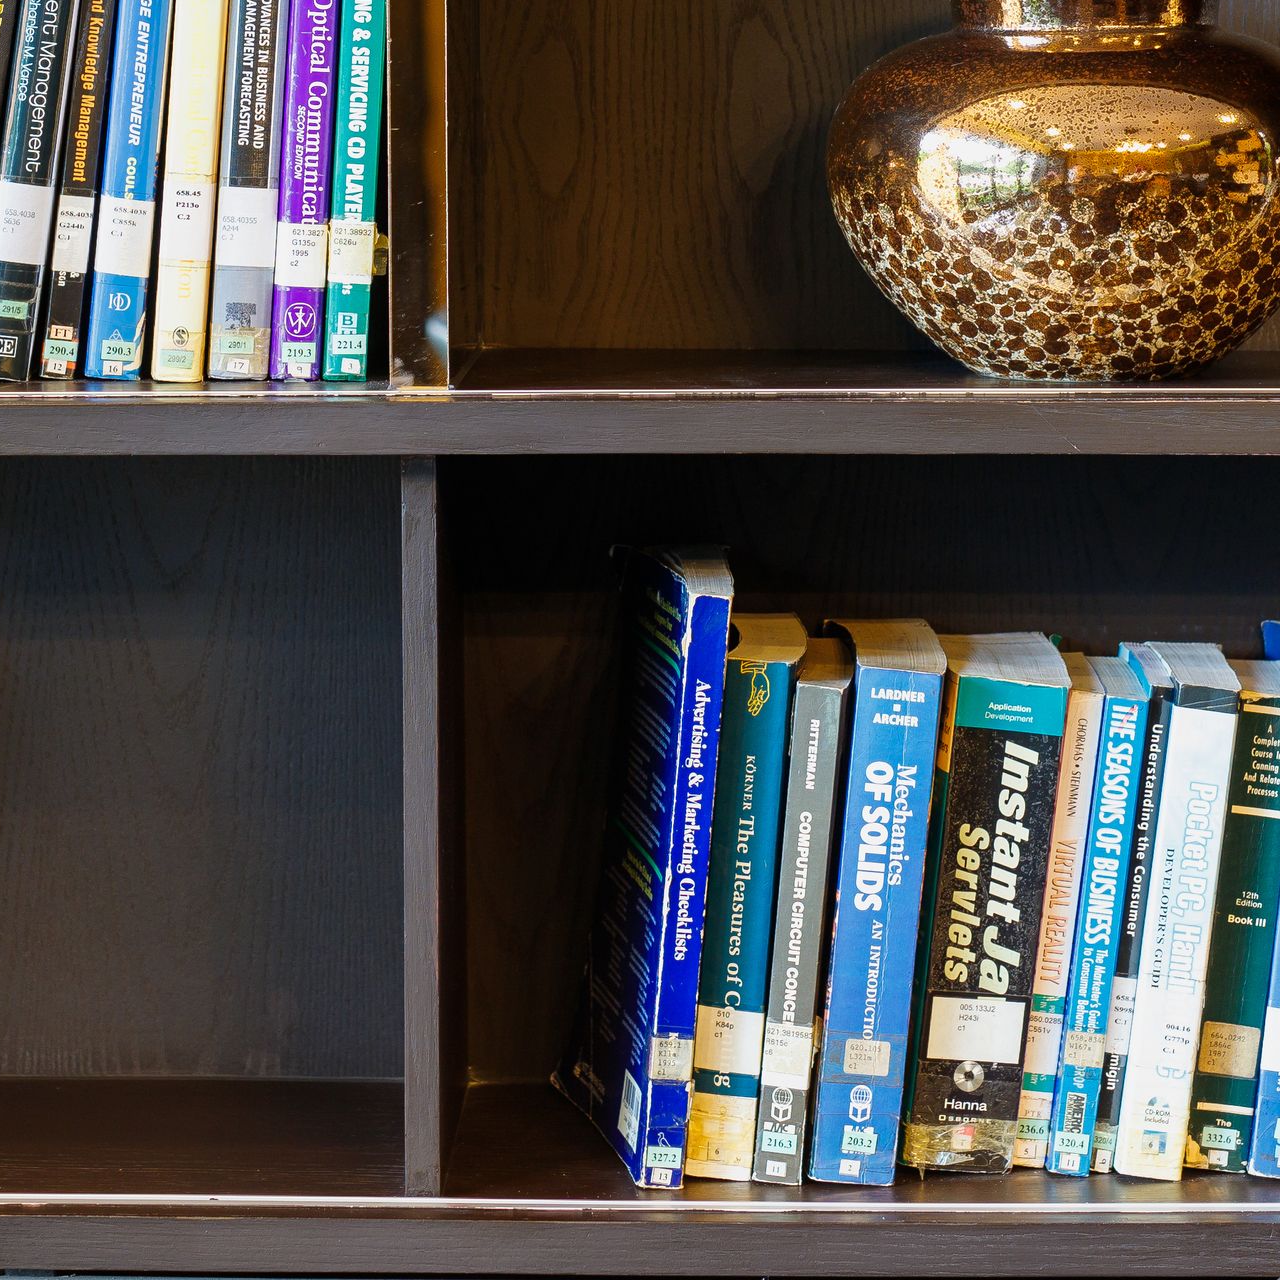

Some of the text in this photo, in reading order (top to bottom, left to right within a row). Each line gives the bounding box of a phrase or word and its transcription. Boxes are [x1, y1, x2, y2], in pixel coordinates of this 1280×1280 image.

[82, 18, 106, 90] Knowledge
[129, 22, 148, 144] ENTREPRENEUR
[73, 94, 101, 182] Management
[294, 147, 304, 179] EDITION
[673, 679, 711, 961] Advertising & Marketing Checklists
[854, 762, 894, 911] OF SOLIDS
[888, 764, 917, 886] Mechanics
[986, 740, 1039, 924] Instant
[1083, 705, 1138, 944] THE SEASONS OF BUSINESS
[726, 816, 754, 985] The Pleasures of
[943, 824, 987, 983] Servlets
